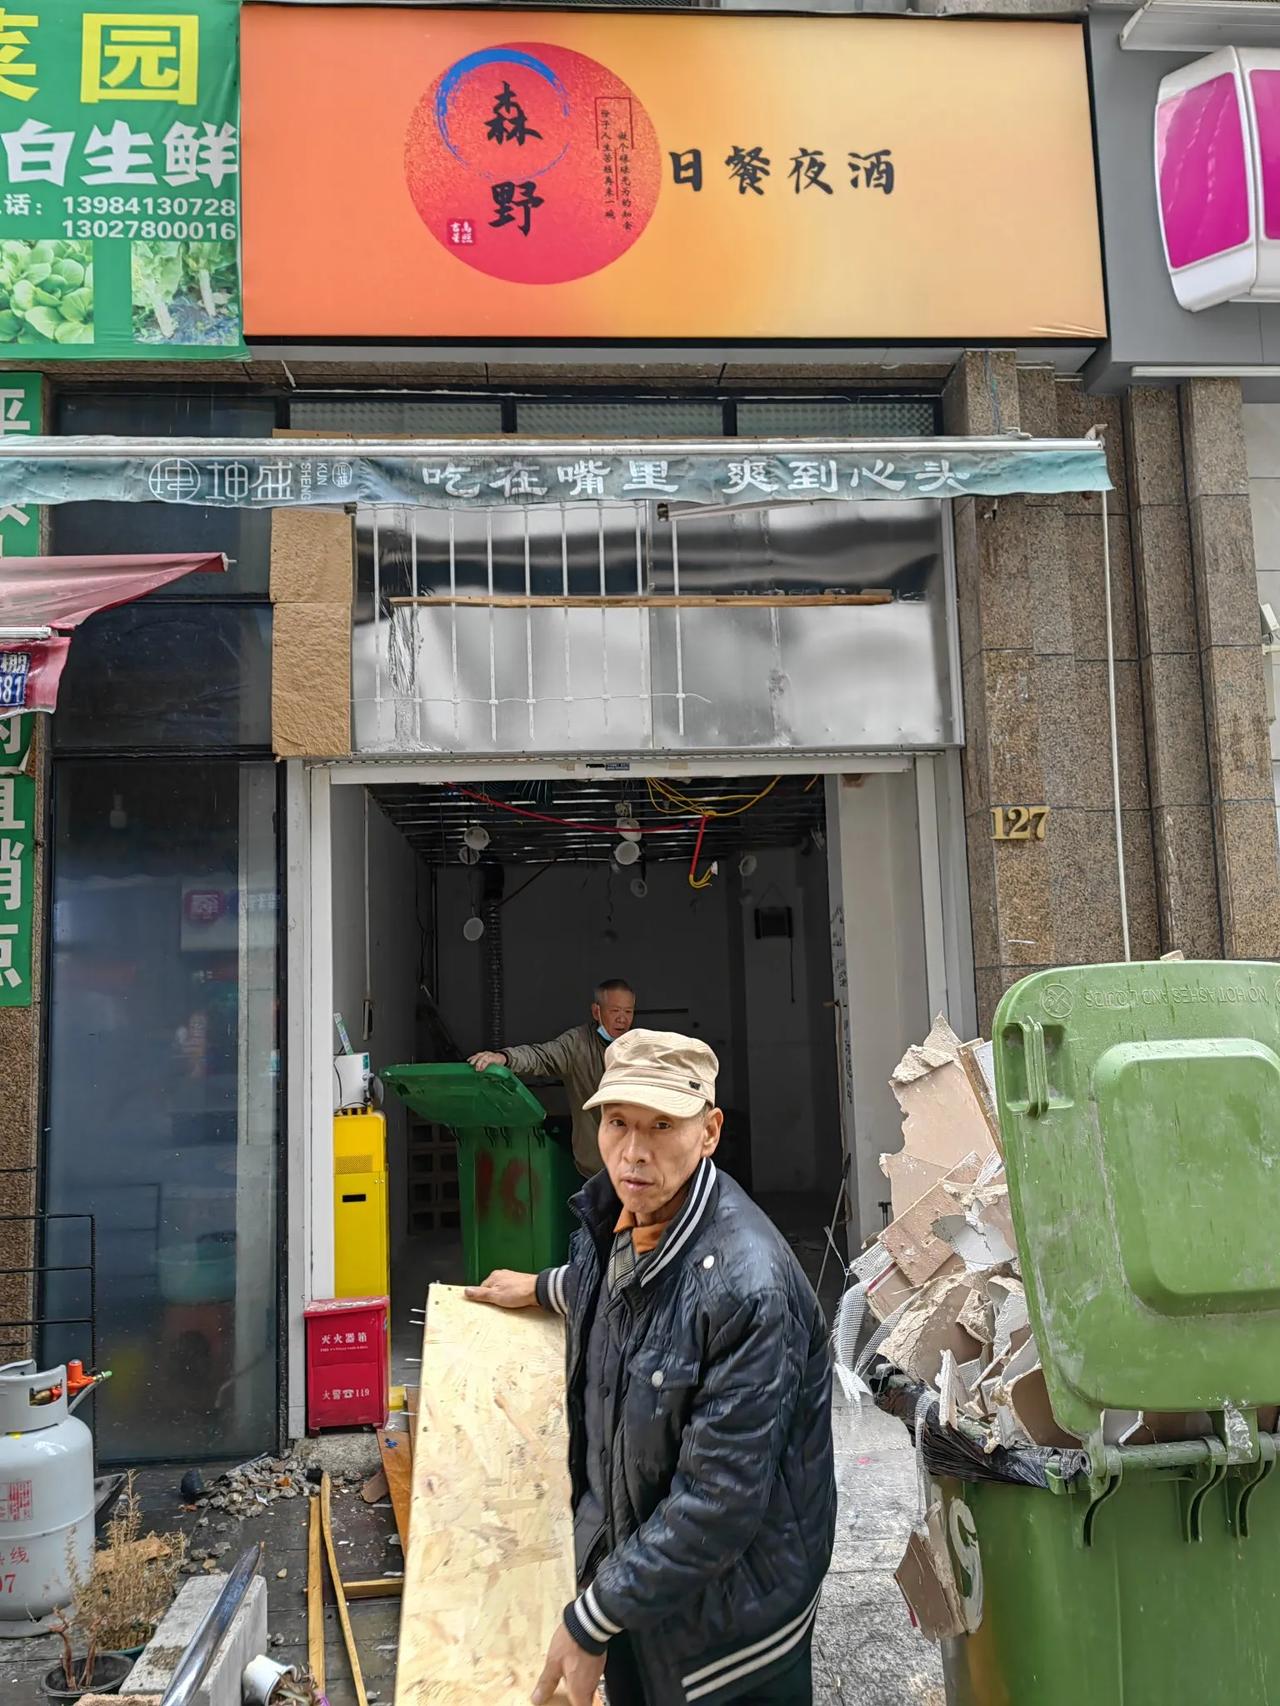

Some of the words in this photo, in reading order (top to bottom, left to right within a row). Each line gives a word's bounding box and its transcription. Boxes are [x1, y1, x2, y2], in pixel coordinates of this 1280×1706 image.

[1, 118, 239, 188] 白生鲜
[484, 80, 545, 237] 森野
[668, 145, 895, 196] 日餐夜酒
[62, 195, 236, 217] 13984130728
[62, 219, 236, 241] 13027800016
[300, 462, 312, 500] SHENG
[317, 462, 328, 486] KUN
[422, 459, 679, 498] 吃在嘴里
[721, 458, 972, 493] 爽到心头
[990, 805, 1051, 840] 127
[1218, 986, 1246, 1003] HOT
[320, 1332, 368, 1345] 灭火器箱
